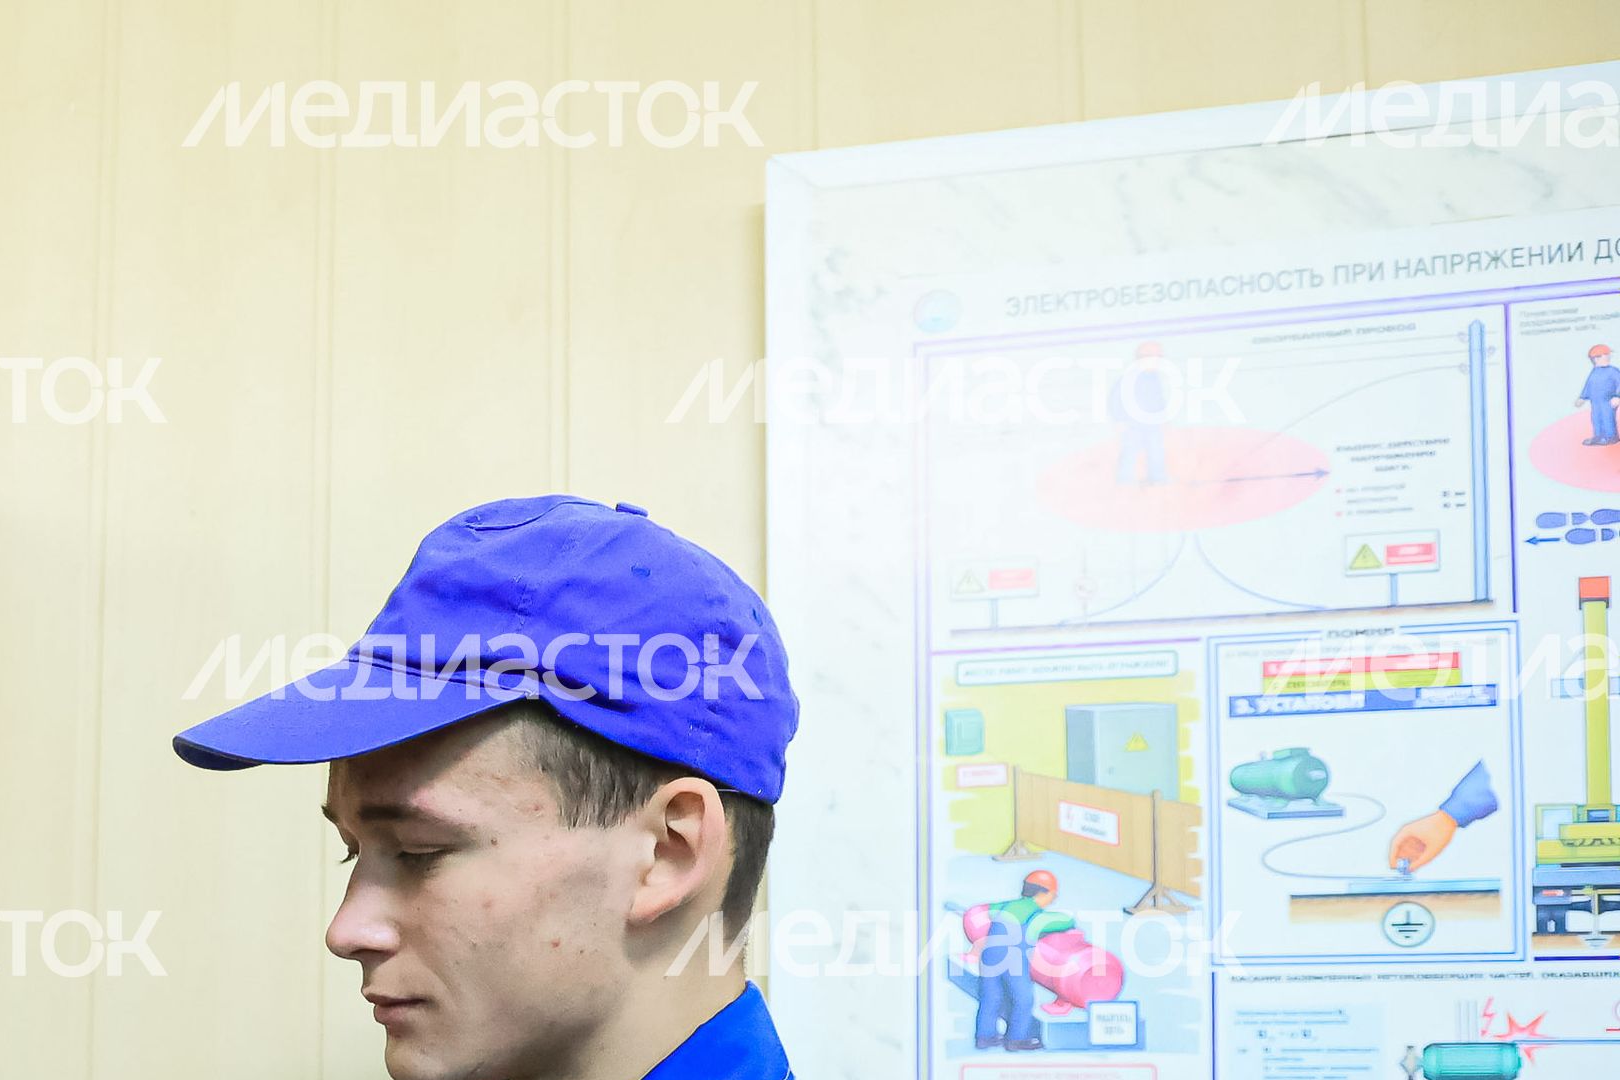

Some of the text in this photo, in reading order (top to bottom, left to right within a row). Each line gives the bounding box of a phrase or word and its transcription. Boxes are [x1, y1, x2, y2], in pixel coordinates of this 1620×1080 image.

[1005, 267, 1324, 318] ЭЛЕКТРОБЕЗОПАСНОСТЬ
[1333, 261, 1384, 286] ПРИ
[1394, 241, 1584, 279] НАПРЯЖЕНИИ
